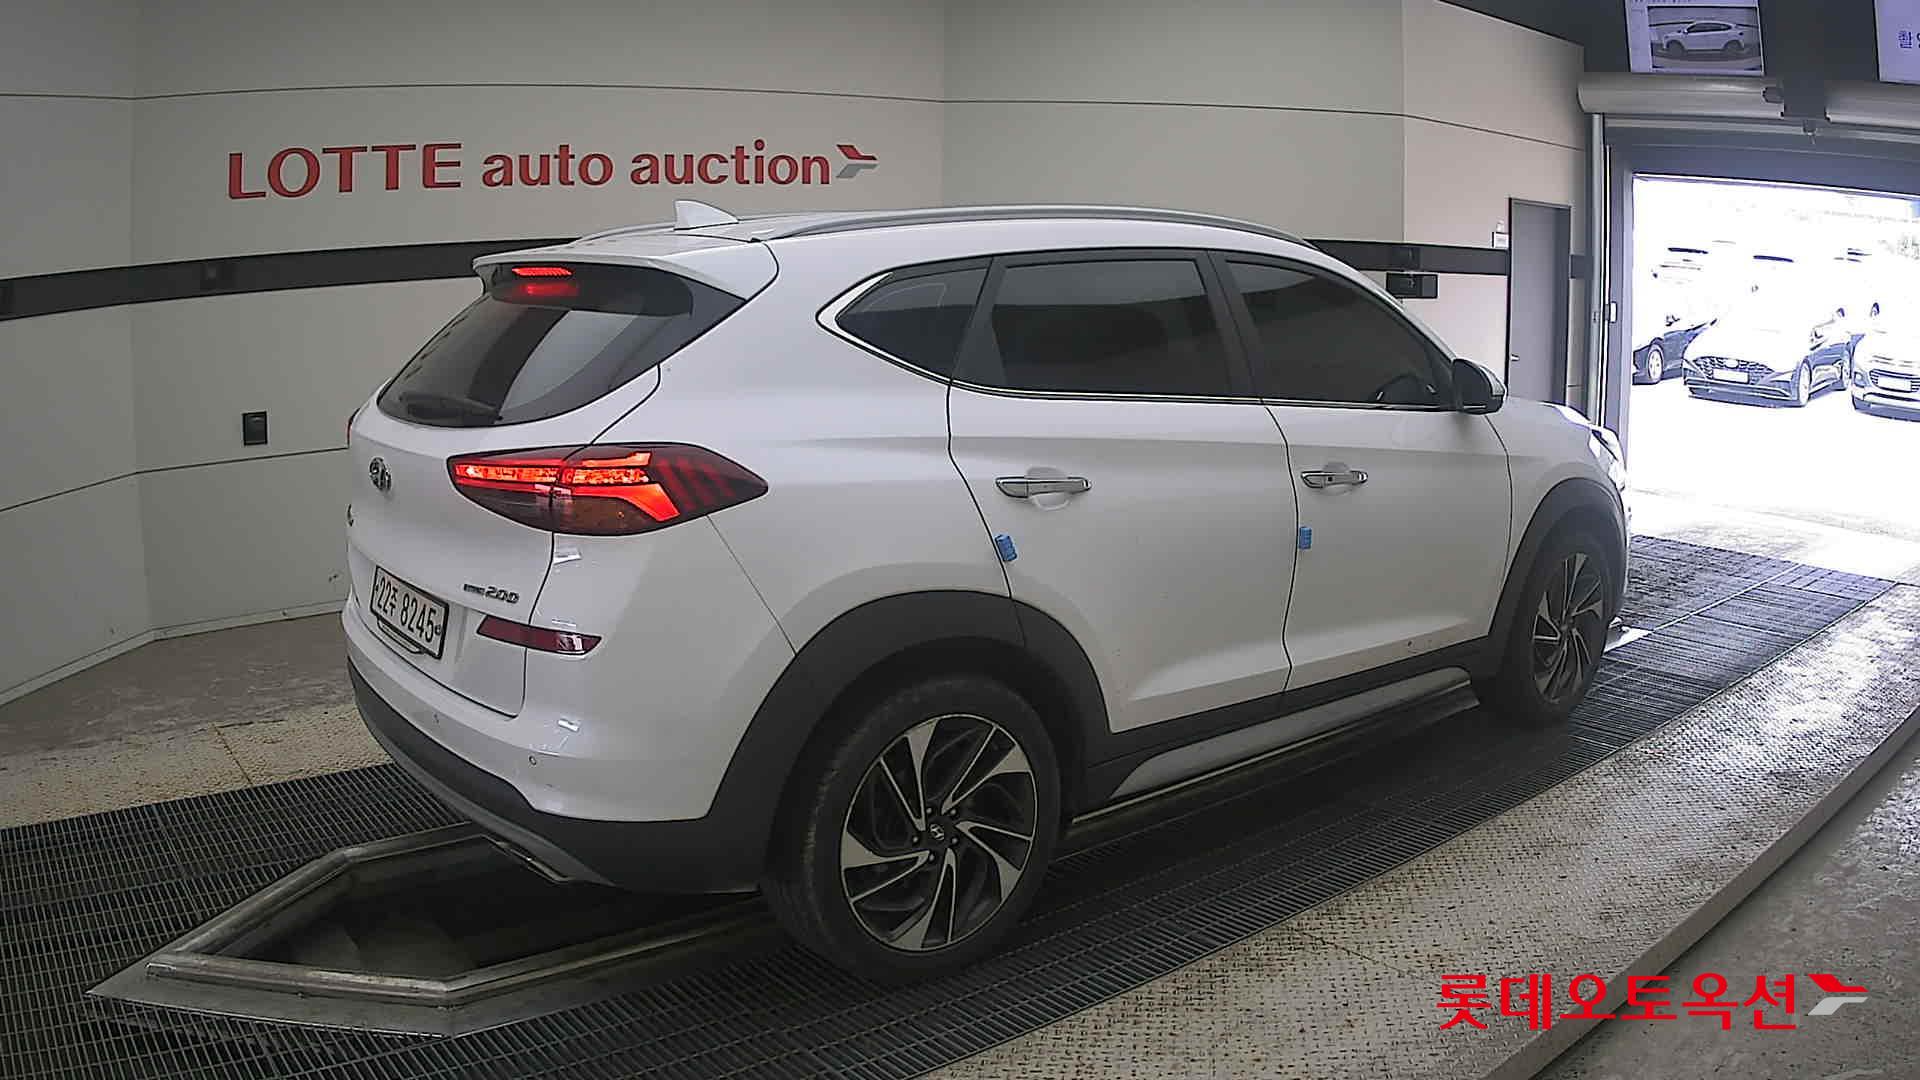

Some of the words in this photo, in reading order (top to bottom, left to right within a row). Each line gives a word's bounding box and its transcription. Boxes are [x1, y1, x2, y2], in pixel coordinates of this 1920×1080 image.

[229, 143, 462, 199] LOTTE
[483, 144, 614, 186] auto
[631, 140, 832, 185] auction
[377, 576, 398, 617] 22주
[400, 593, 437, 643] 8245
